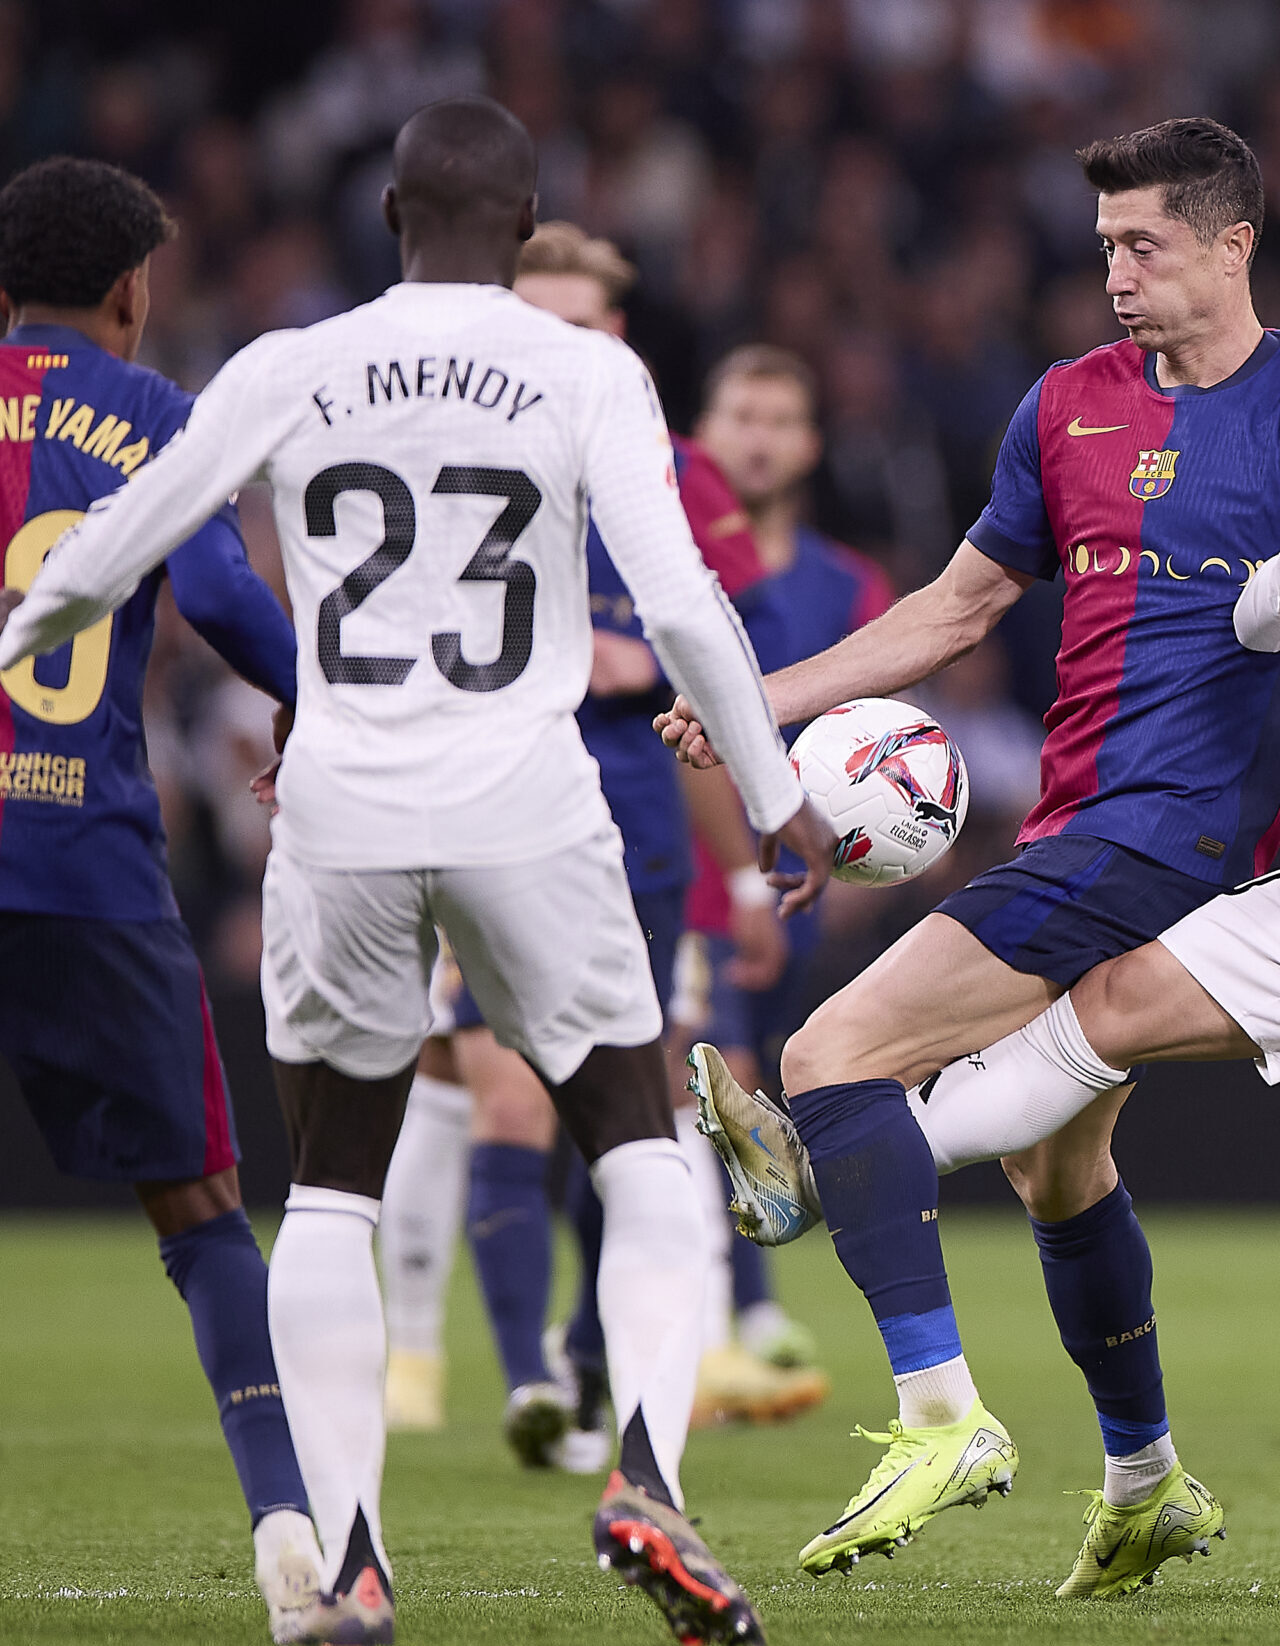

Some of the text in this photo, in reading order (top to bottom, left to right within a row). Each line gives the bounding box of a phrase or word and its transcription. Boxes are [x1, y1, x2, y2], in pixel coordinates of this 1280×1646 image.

[312, 356, 545, 427] F. MENDY
[44, 398, 153, 482] YAMA
[303, 461, 544, 693] 23
[0, 752, 86, 778] UNHCR
